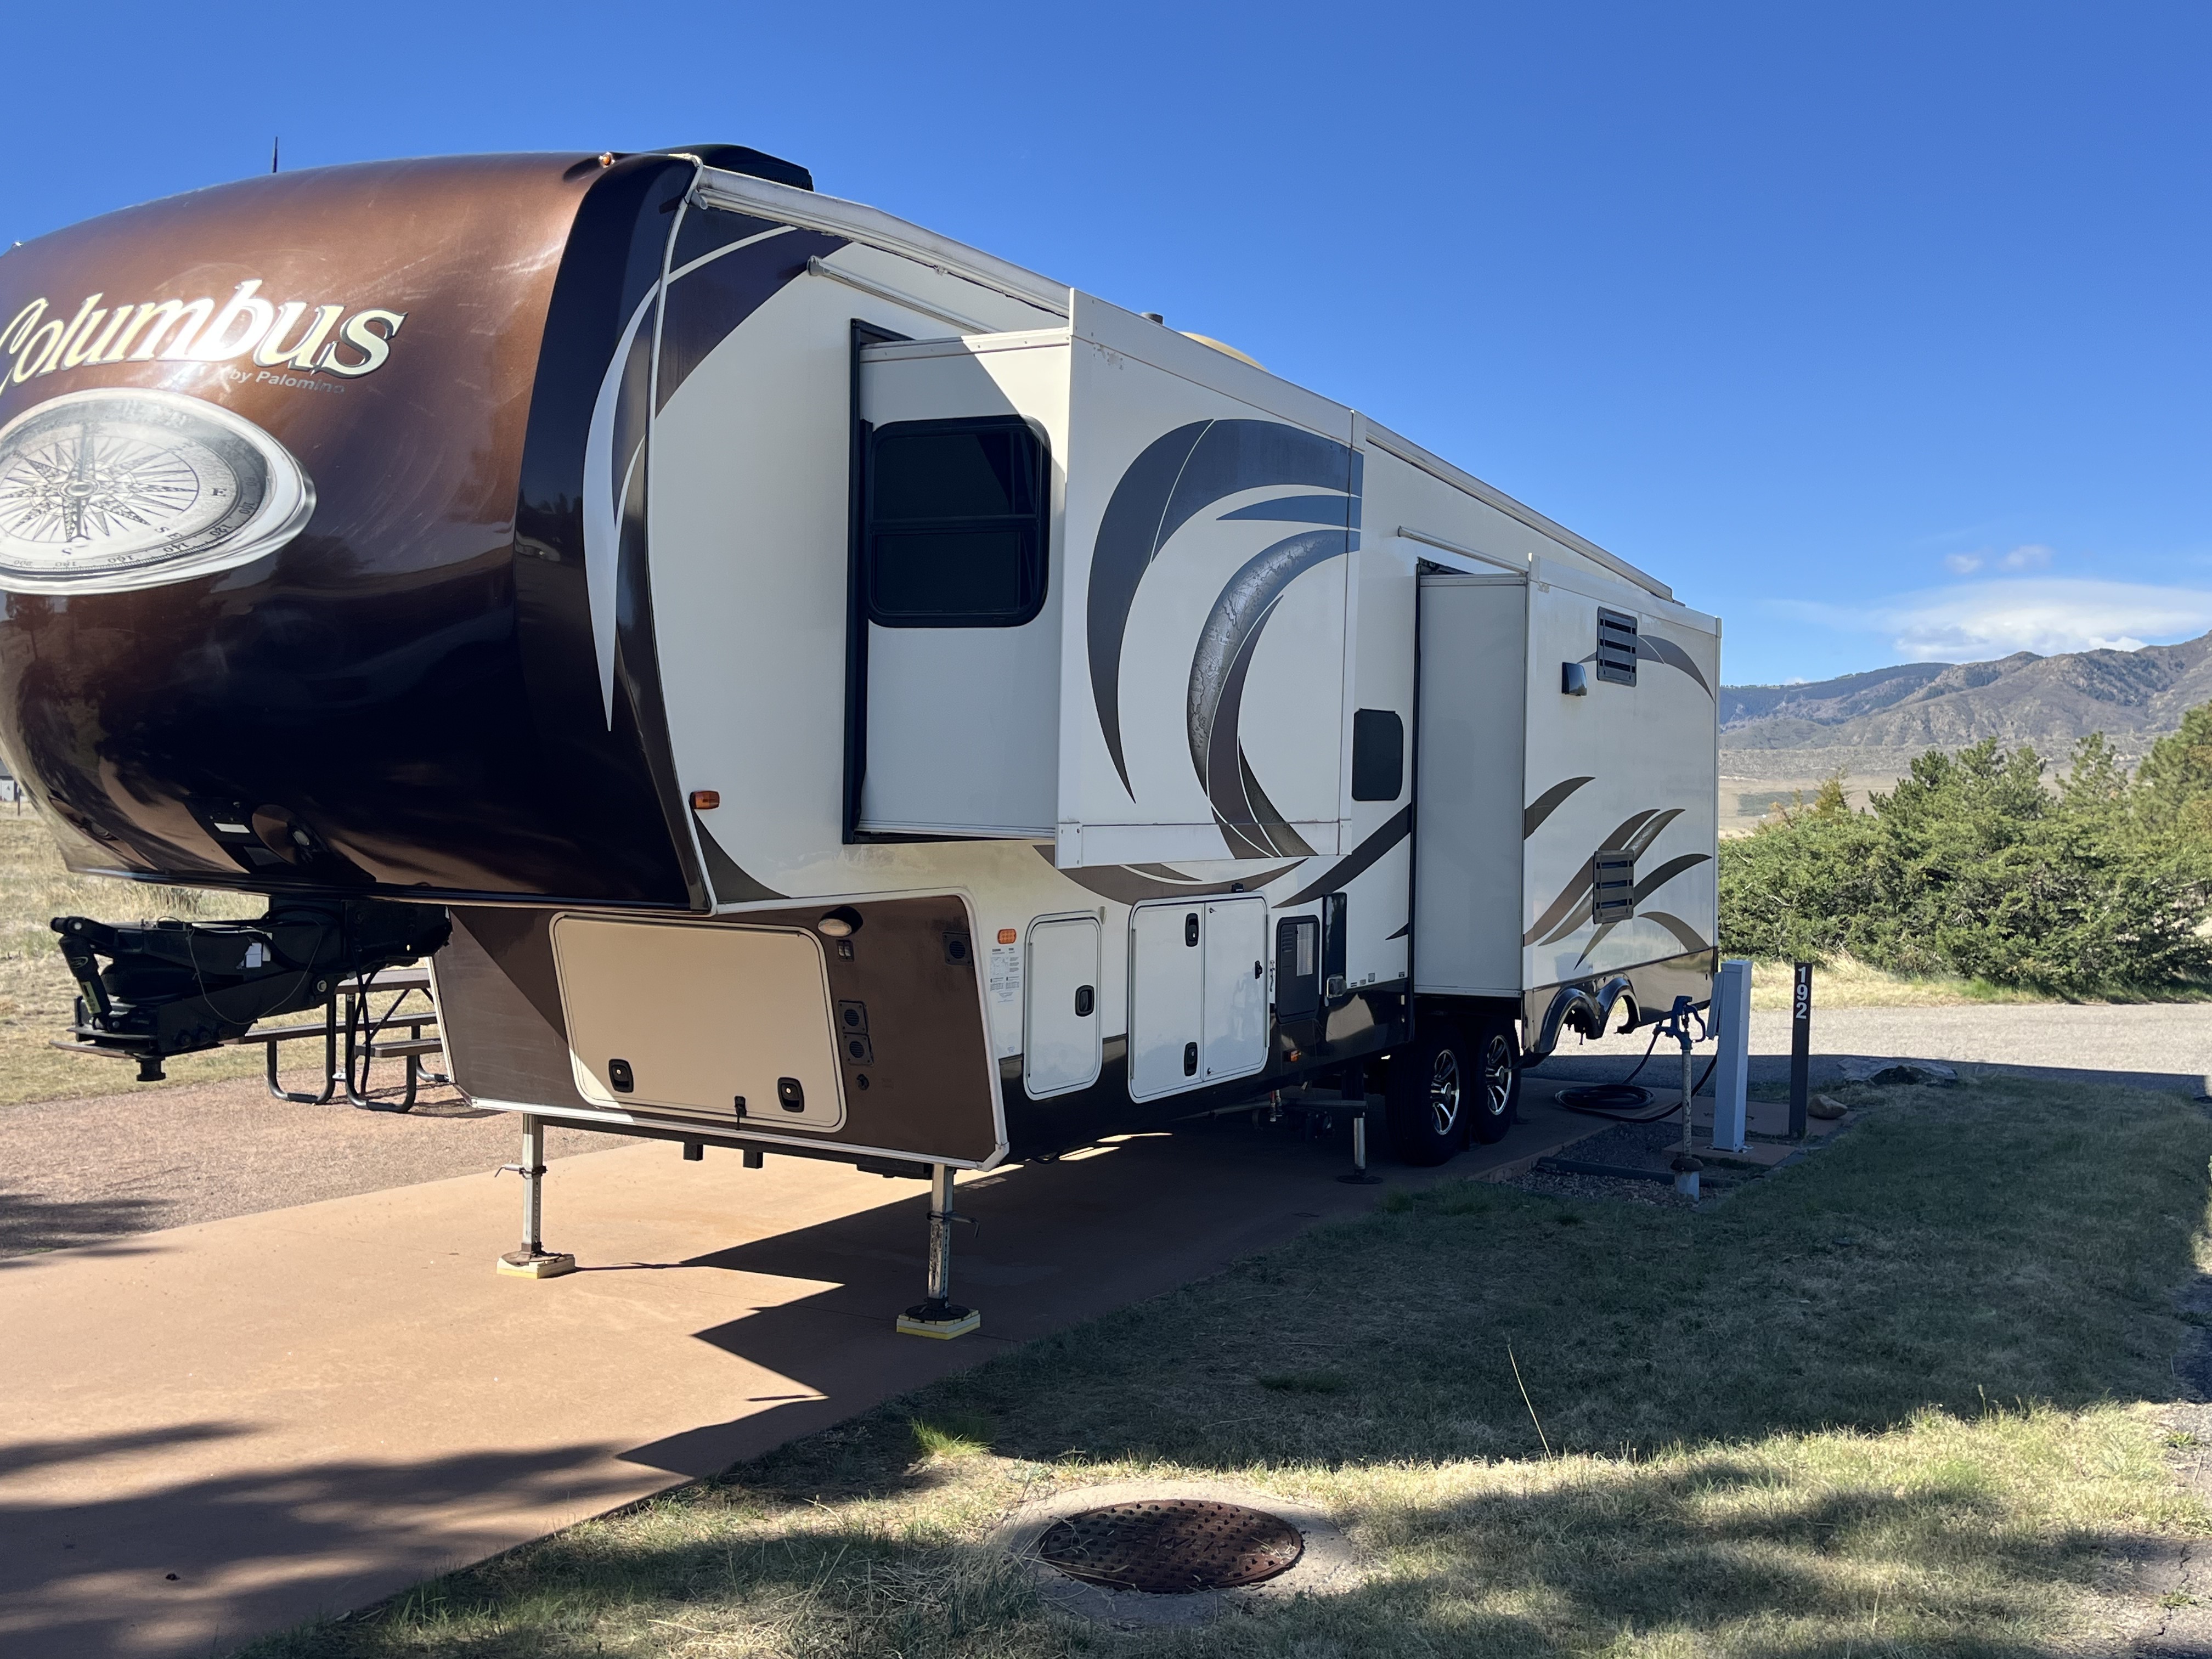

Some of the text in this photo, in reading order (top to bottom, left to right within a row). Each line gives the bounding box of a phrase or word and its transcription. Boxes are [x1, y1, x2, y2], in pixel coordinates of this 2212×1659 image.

[0, 279, 409, 394] Columbus
[229, 368, 346, 394] by Palomino
[212, 488, 227, 497] E
[239, 501, 256, 515] 100
[210, 523, 233, 537] 120
[162, 541, 189, 554] 140
[1796, 966, 1808, 1019] 192
